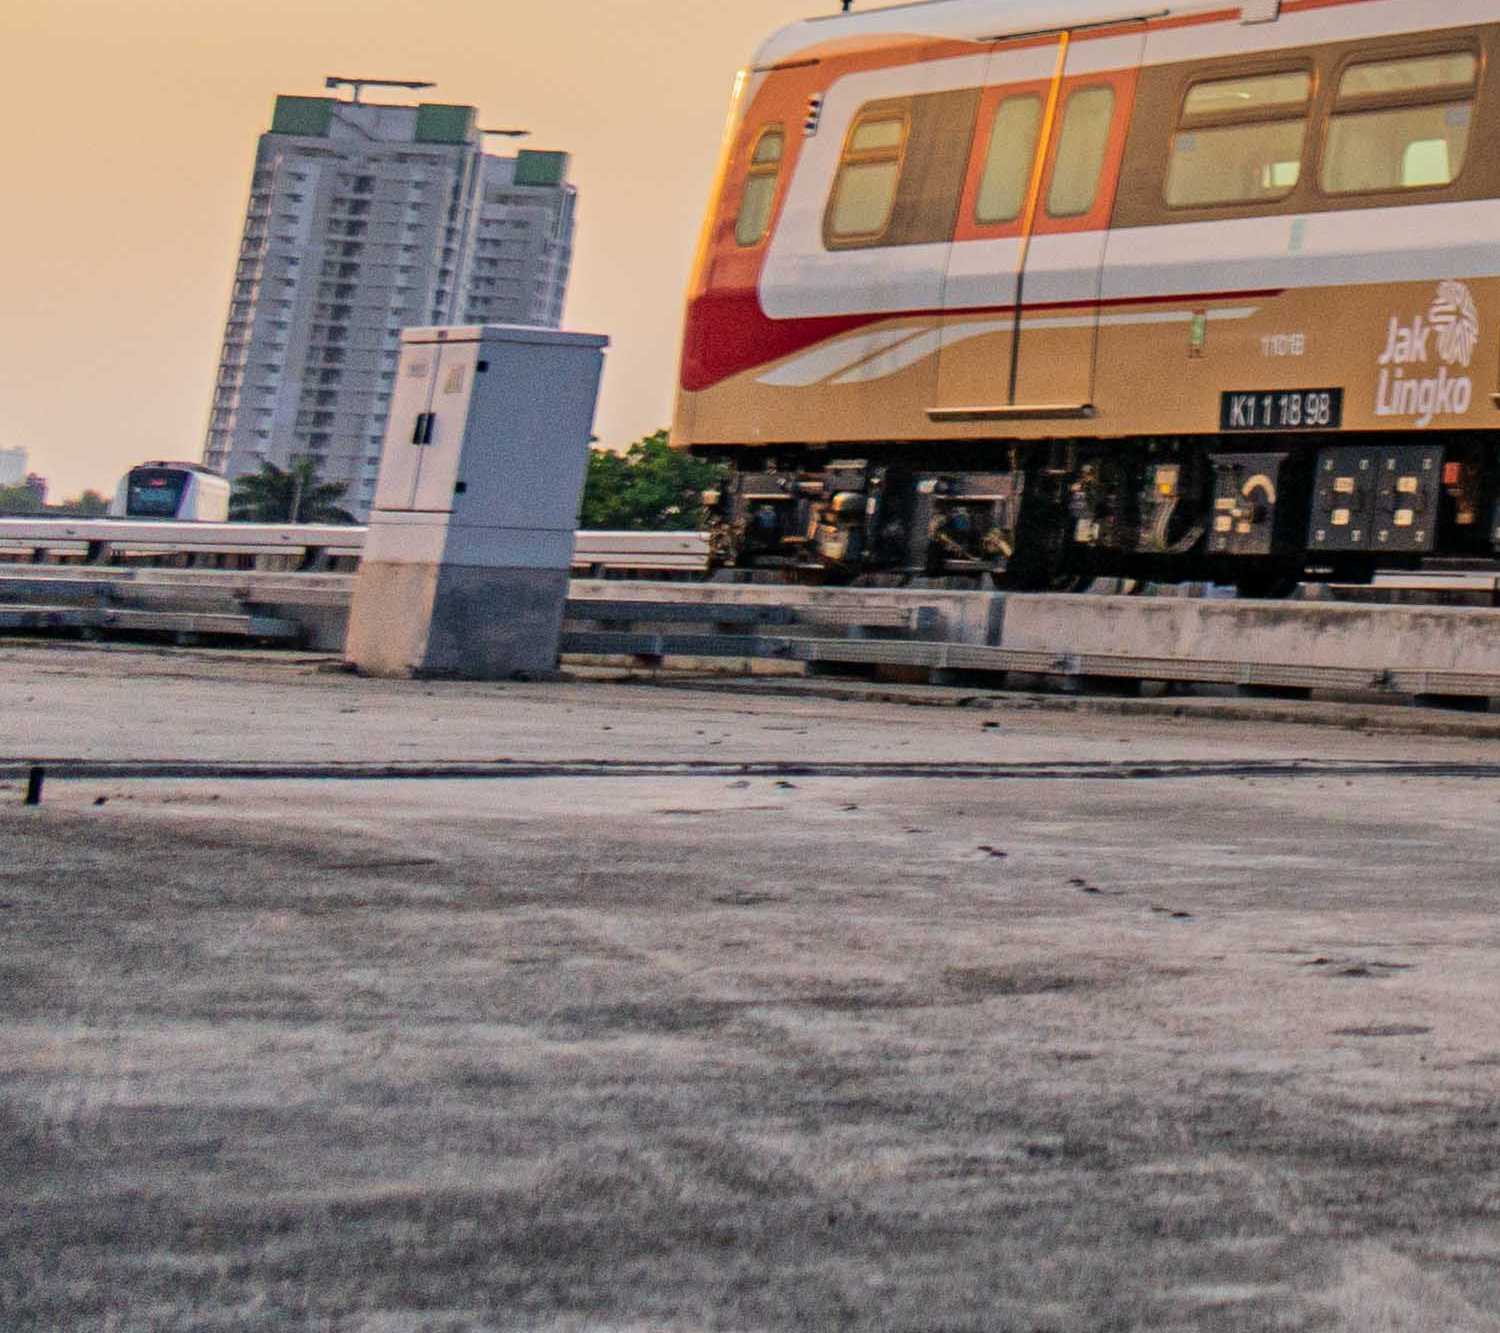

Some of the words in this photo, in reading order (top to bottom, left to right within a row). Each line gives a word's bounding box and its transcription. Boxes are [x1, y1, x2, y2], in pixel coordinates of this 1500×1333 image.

[1377, 315, 1430, 364] Jak
[1230, 395, 1256, 427] K1
[1260, 395, 1273, 426] 1
[1278, 393, 1301, 425] 18
[1303, 392, 1330, 425] 98
[1375, 365, 1472, 428] Lingko
